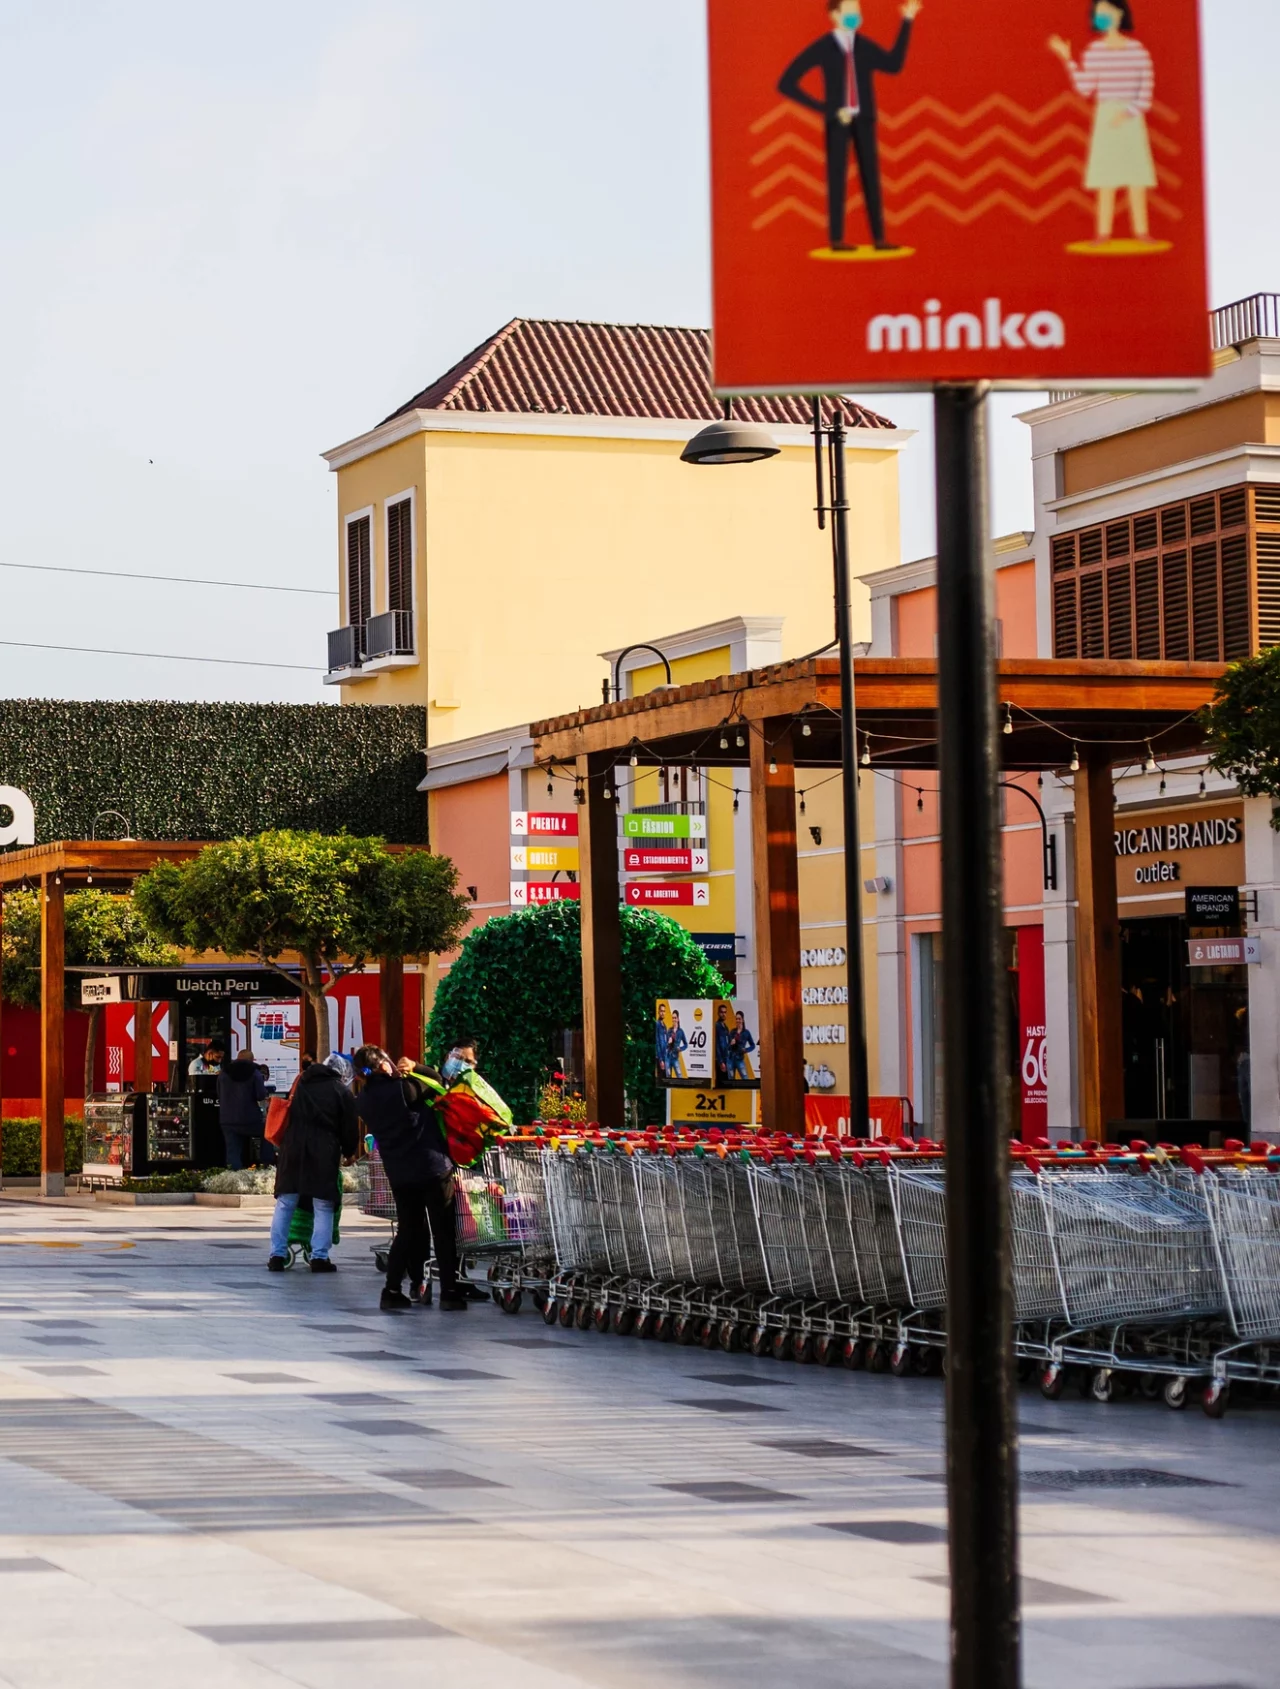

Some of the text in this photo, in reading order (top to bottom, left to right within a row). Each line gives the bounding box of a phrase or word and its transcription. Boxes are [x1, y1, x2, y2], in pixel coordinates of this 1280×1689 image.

[867, 298, 1065, 352] minka
[531, 817, 567, 831] PUERTA 4
[642, 821, 674, 834] FASHION
[1168, 818, 1238, 850] BRANDS
[530, 852, 558, 865] OUTLET
[1135, 861, 1175, 884] outlet
[1191, 895, 1234, 903] AMERICAN
[1196, 904, 1230, 913] BRANDS
[1206, 945, 1240, 959] LACTARIO
[177, 979, 259, 991] Watch Peru
[689, 1031, 707, 1048] 40
[695, 1093, 726, 1111] 2x1
